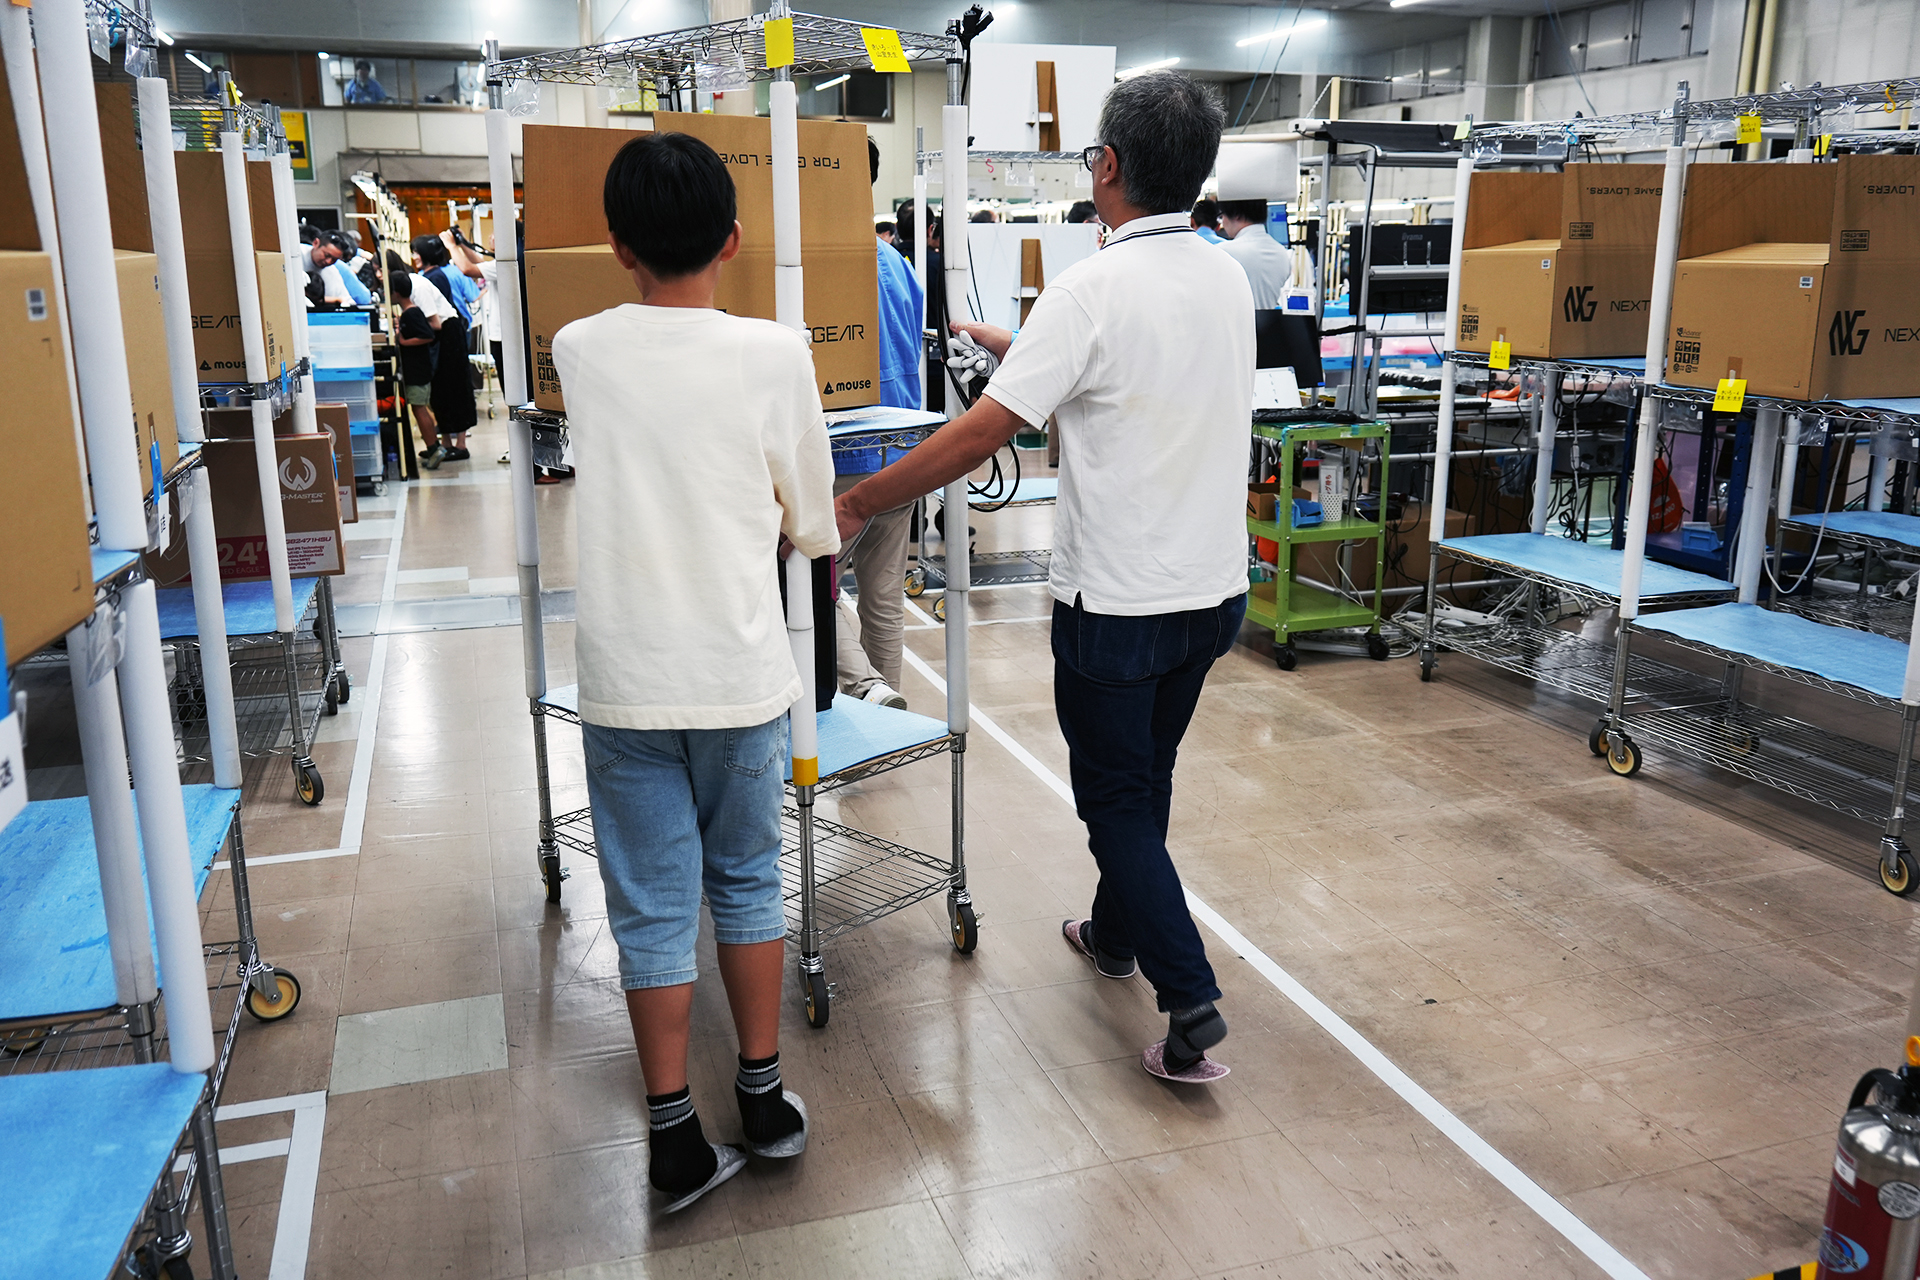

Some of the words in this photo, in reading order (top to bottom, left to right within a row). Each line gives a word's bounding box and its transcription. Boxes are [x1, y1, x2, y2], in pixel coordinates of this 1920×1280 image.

[813, 156, 840, 169] FOR
[1586, 187, 1630, 196] LOVERS.
[1634, 187, 1663, 196] GAME
[1863, 185, 1915, 195] LOVERS.
[1610, 300, 1651, 312] NEXT
[806, 325, 864, 343] GEAR
[836, 379, 871, 392] mouse
